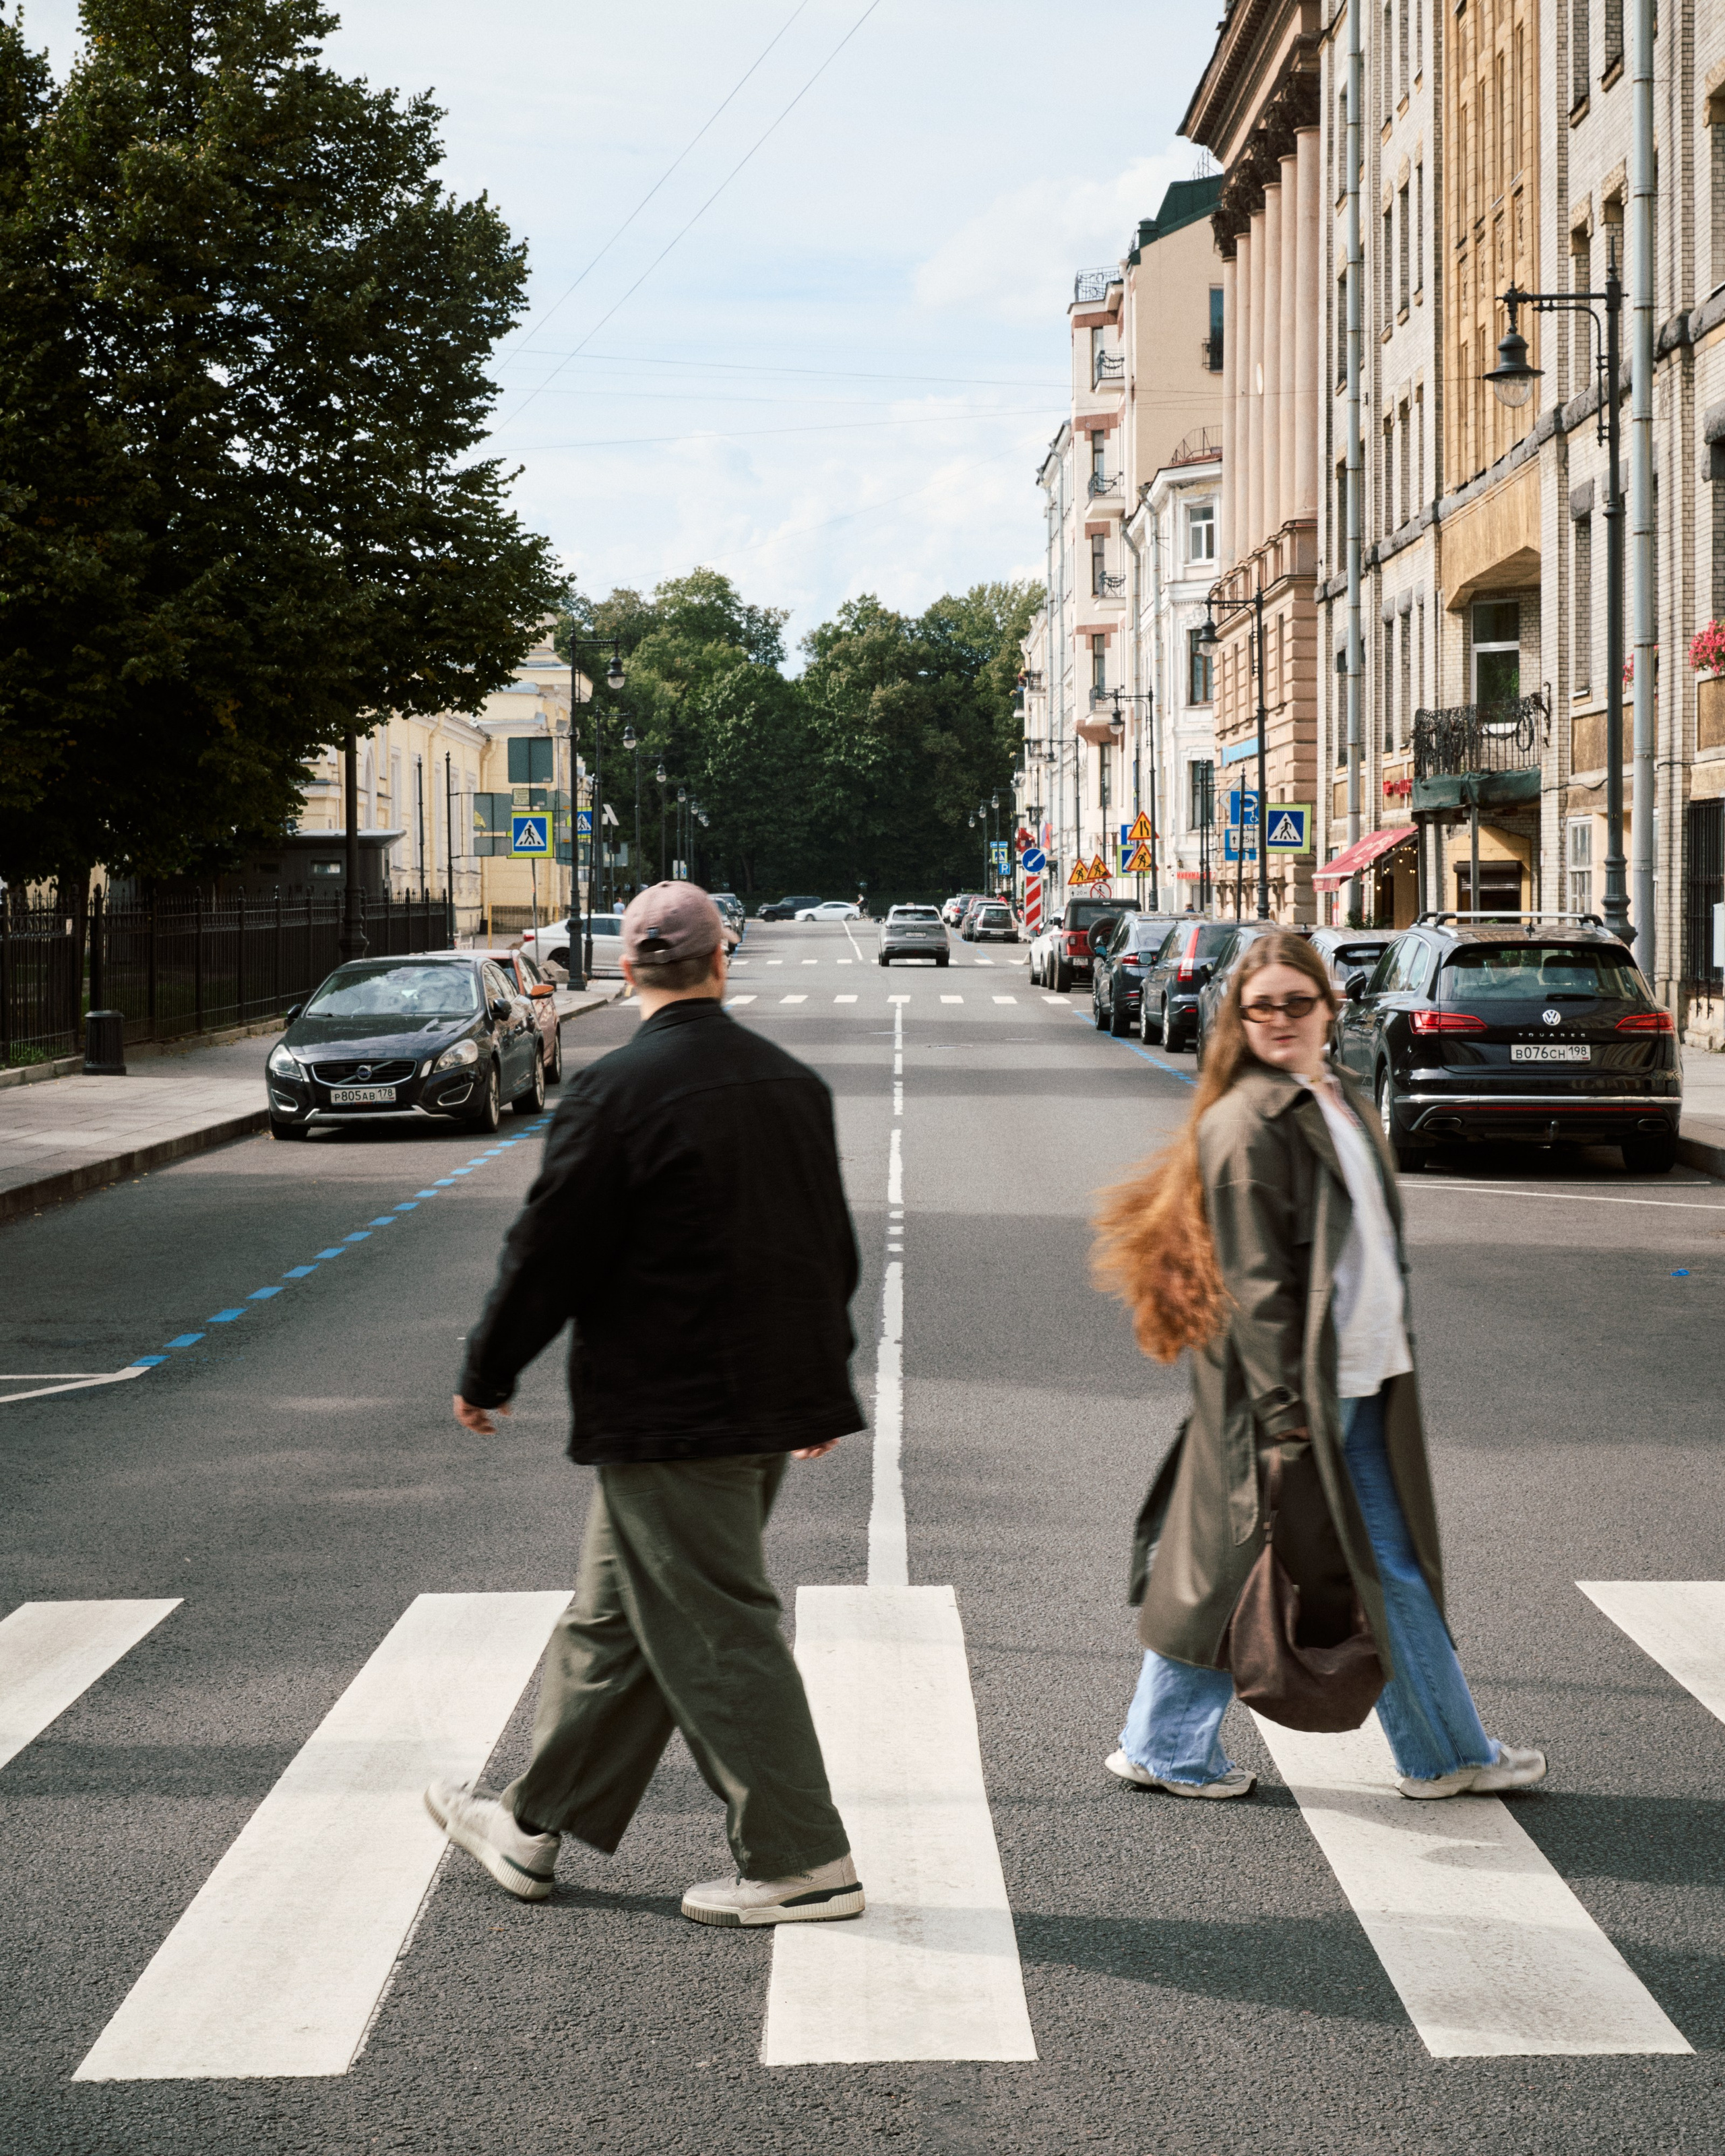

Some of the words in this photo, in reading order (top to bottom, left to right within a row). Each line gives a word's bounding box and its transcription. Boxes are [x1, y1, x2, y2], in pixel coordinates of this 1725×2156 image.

[1515, 1046, 1565, 1059] В076СН
[1568, 1046, 1587, 1056] 198
[334, 1090, 375, 1102] Р805АВ
[377, 1088, 393, 1097] 178
